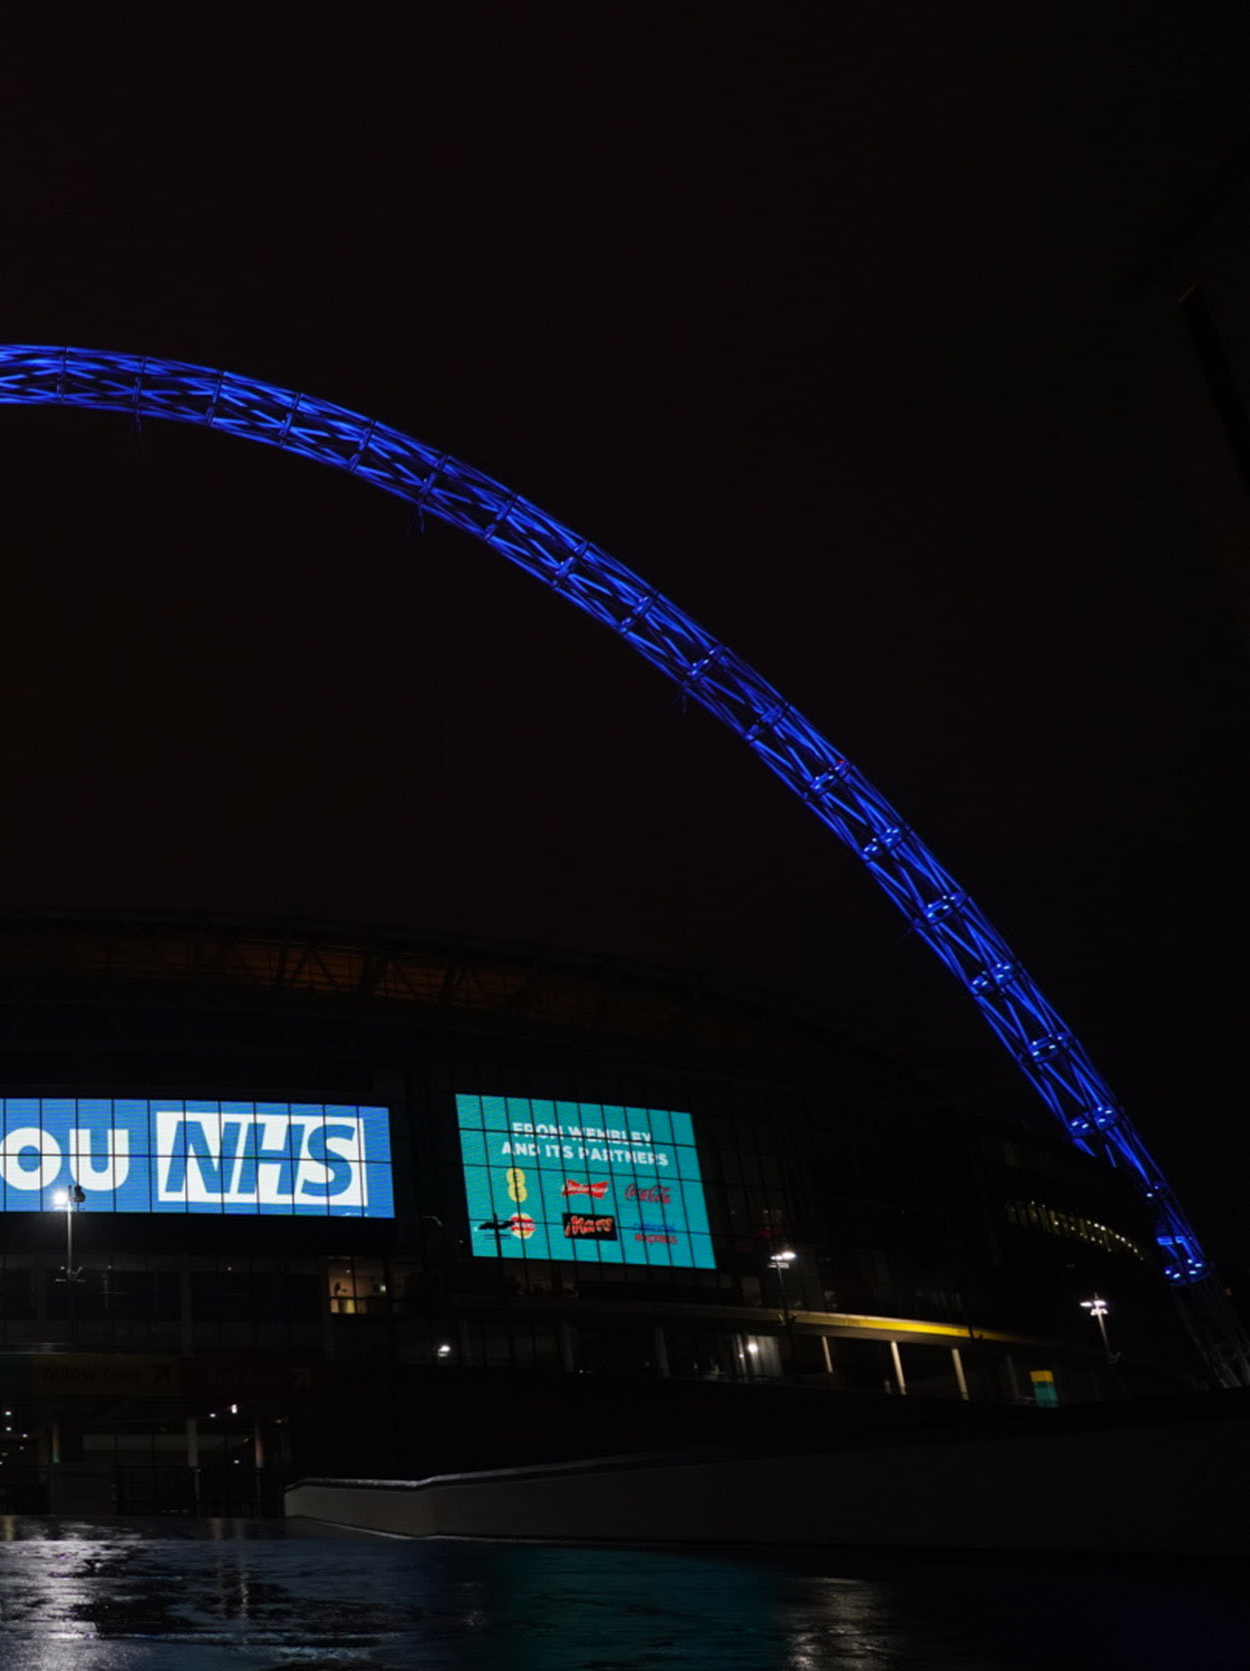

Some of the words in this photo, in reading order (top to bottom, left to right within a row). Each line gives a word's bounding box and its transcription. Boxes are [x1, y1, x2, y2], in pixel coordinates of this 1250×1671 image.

[512, 1122, 564, 1140] FROM
[568, 1125, 652, 1147] WEMBLEY
[165, 1120, 356, 1197] NHS
[501, 1141, 540, 1156] AND
[546, 1145, 574, 1159] ITS
[578, 1147, 669, 1167] PARTNERS
